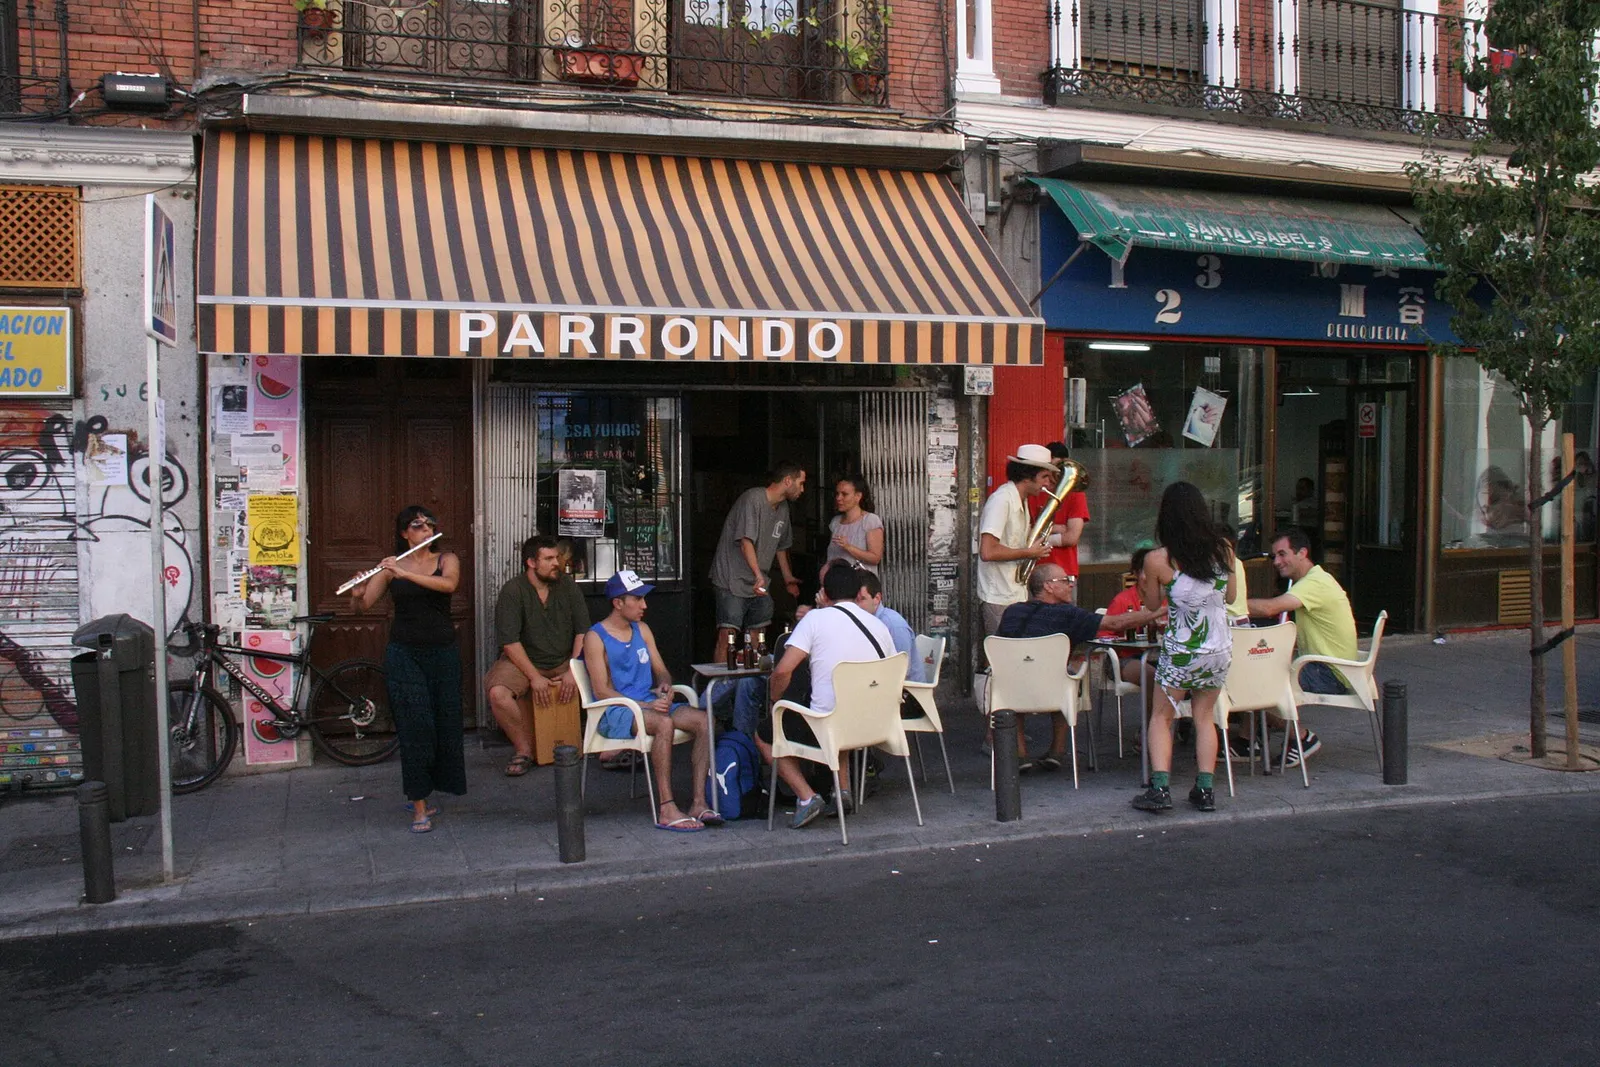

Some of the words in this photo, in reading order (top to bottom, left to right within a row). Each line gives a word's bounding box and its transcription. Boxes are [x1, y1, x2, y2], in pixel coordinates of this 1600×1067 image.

[1185, 222, 1245, 240] SANTA
[1248, 229, 1315, 245] ISABEL
[1155, 289, 1181, 324] 2
[1195, 254, 1222, 289] 3
[459, 313, 844, 358] PARRONDO
